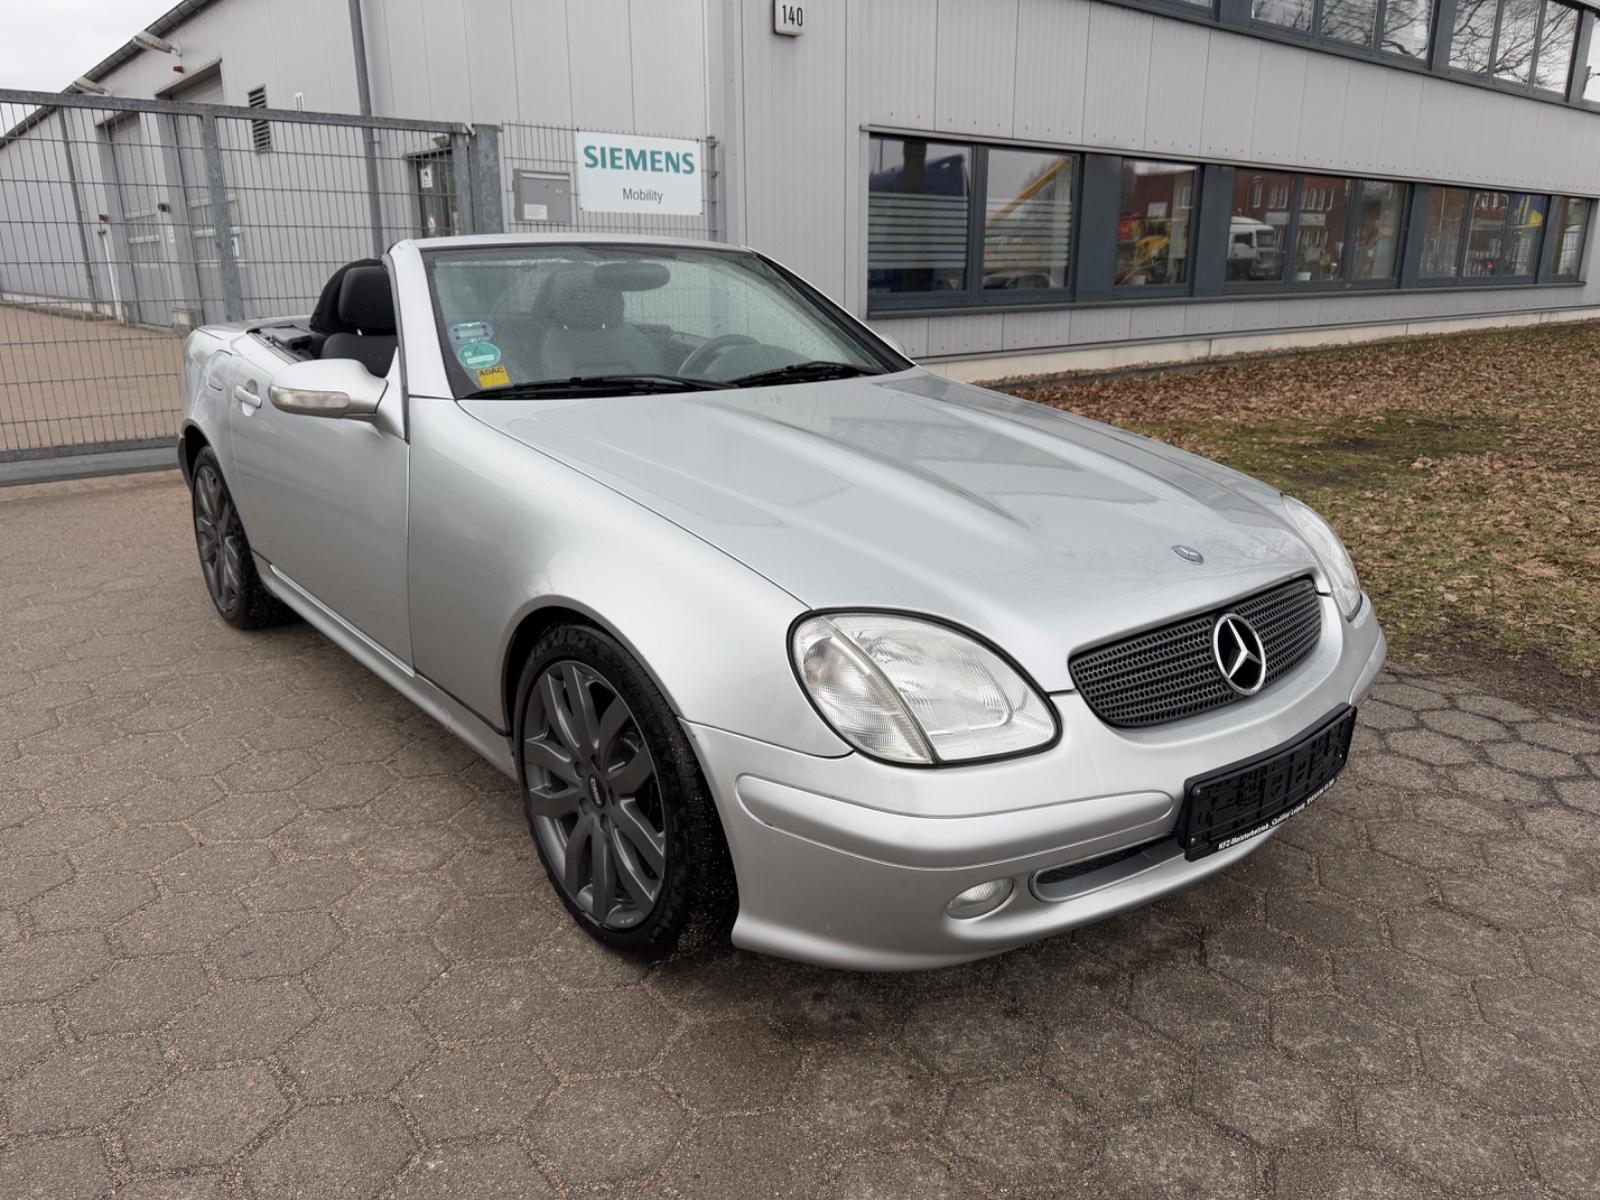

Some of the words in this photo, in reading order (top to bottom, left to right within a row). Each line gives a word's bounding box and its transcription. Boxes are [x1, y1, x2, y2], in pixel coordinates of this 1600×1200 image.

[782, 4, 803, 27] 140
[583, 145, 695, 175] SIEMENS
[622, 188, 663, 205] Mobility
